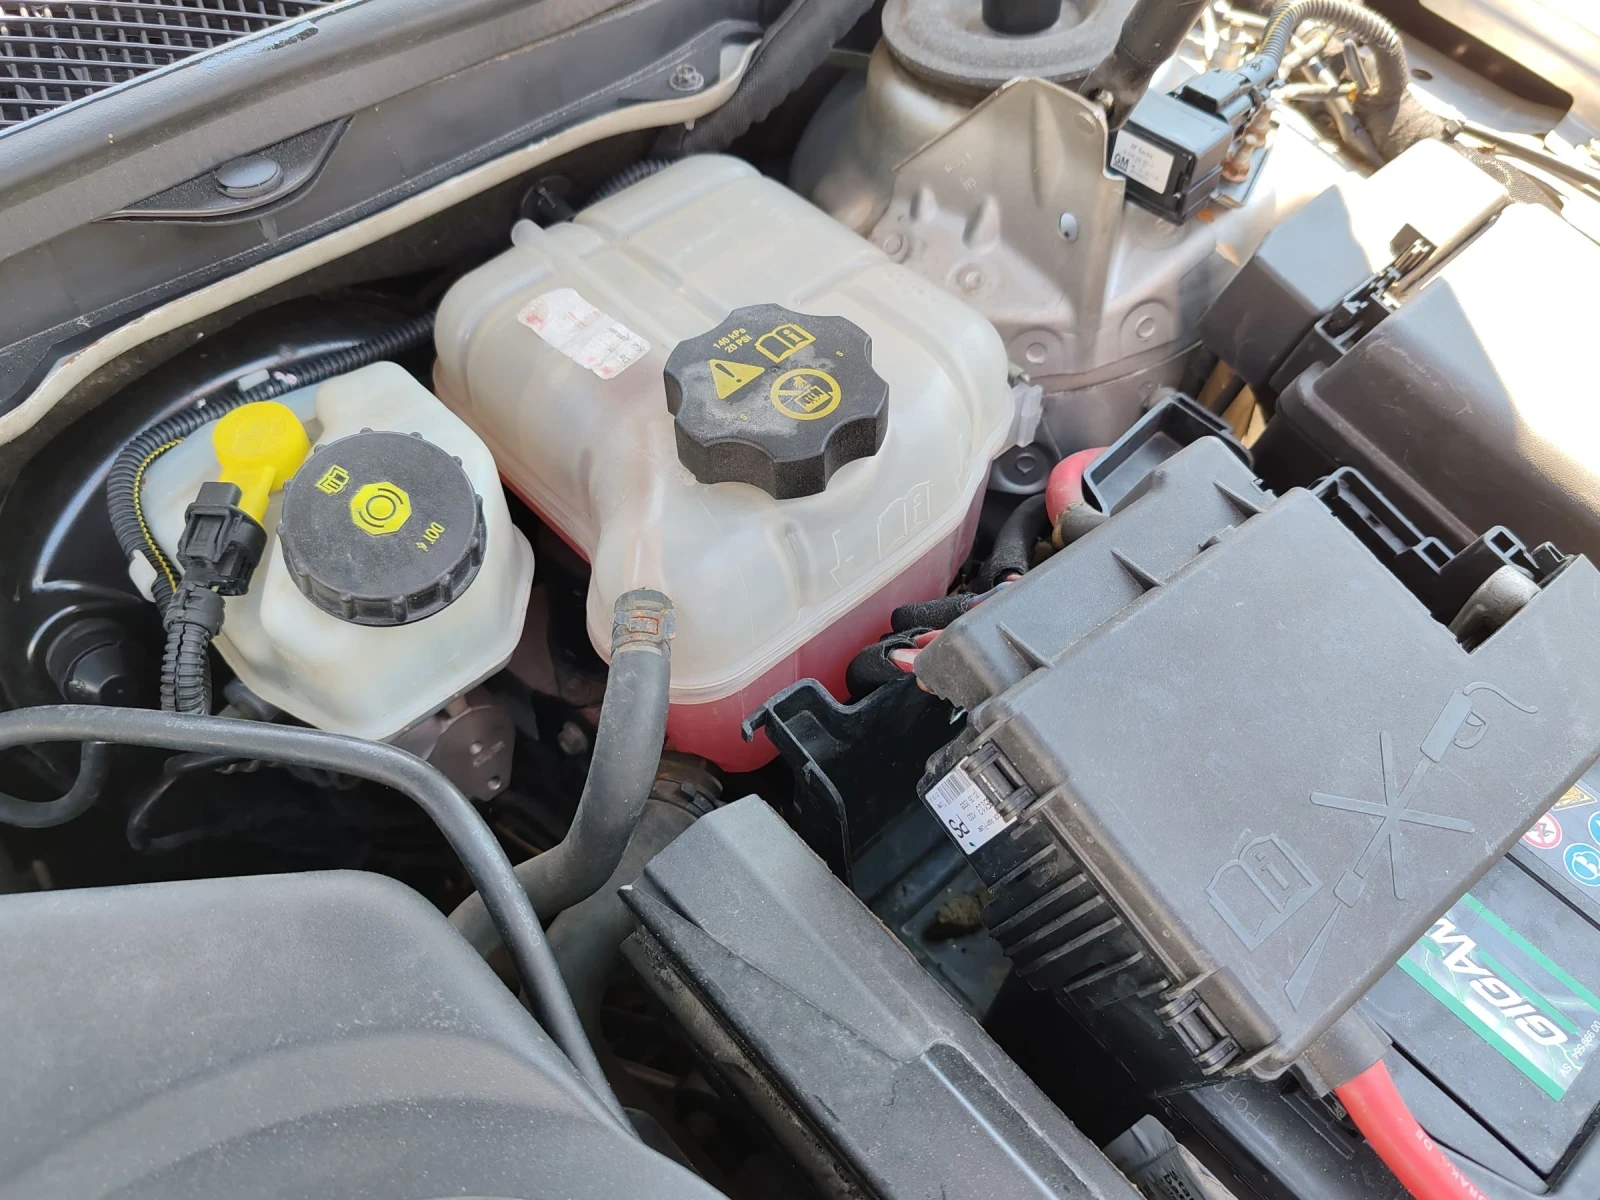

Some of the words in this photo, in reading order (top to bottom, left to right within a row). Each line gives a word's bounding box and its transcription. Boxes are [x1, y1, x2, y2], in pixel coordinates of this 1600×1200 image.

[1114, 152, 1130, 170] GM
[712, 336, 731, 350] 140
[727, 327, 747, 340] kPa
[724, 343, 739, 354] 20
[735, 334, 753, 347] PSI
[422, 521, 446, 545] DOT
[415, 541, 429, 552] 4
[948, 812, 971, 839] PS
[1559, 1062, 1573, 1080] SV
